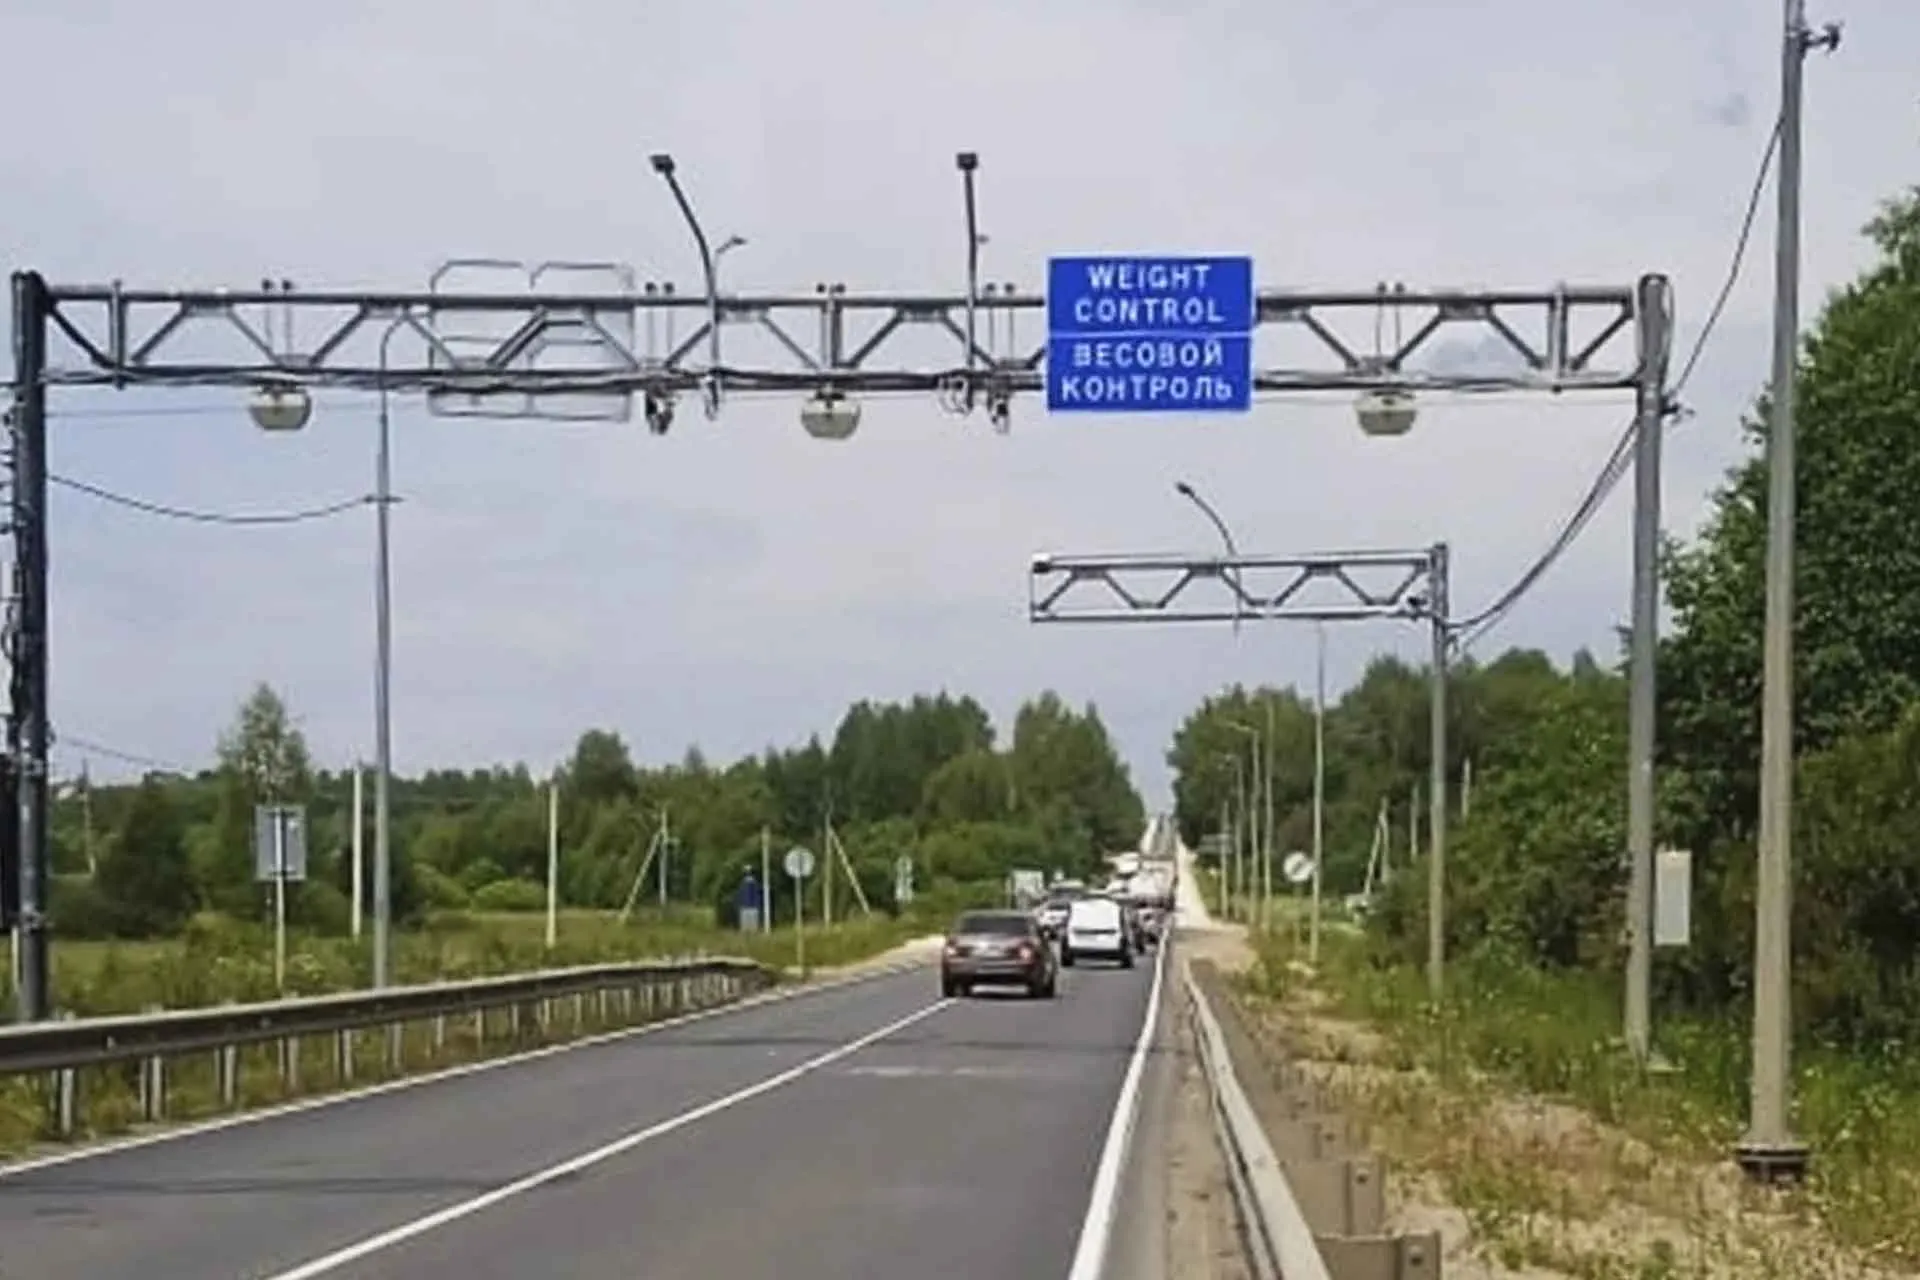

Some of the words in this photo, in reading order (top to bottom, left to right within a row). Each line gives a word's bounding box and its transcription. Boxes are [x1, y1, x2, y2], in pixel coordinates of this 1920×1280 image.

[1088, 264, 1210, 290] WEIGHT
[1074, 297, 1224, 323] CONTROL
[1073, 338, 1223, 367] ВЕСОВОЙ
[1061, 375, 1232, 401] КОНТРОЛЬ
